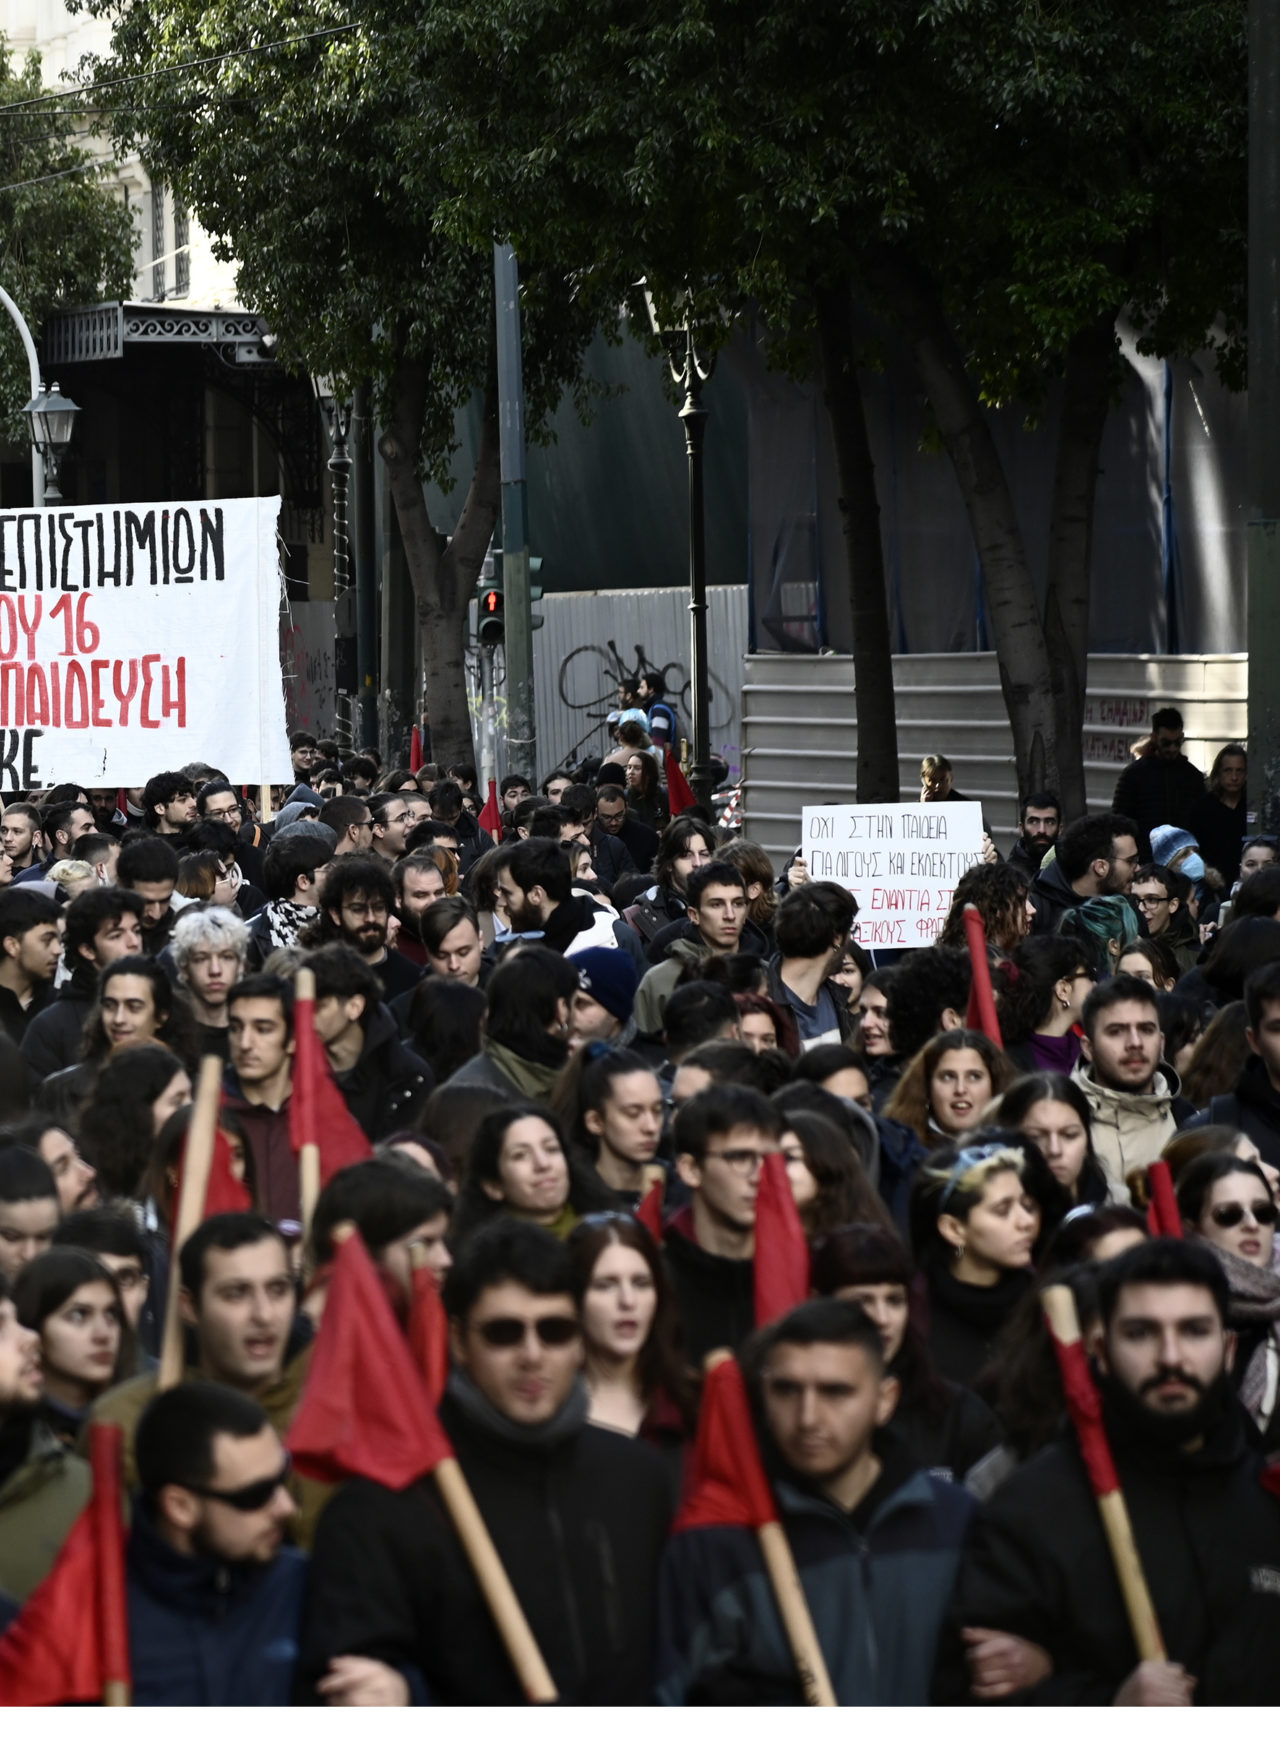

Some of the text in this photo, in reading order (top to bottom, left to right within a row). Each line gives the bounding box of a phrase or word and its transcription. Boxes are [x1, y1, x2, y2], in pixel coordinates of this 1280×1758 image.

[49, 592, 101, 656] 16
[810, 813, 948, 840] ΟΧΙ ΣΤΗΝ ΠΑΙΔΕΙΑ
[811, 850, 832, 876] ΓΙΑ
[836, 851, 884, 878] ΛΙΓΟΥΣ
[889, 852, 905, 877] ΚΑΙ
[871, 888, 954, 911] ΕΝΑΝΤΙΑ ΣΤ
[853, 920, 907, 944] ΑΞΙΚΟΥΣ
